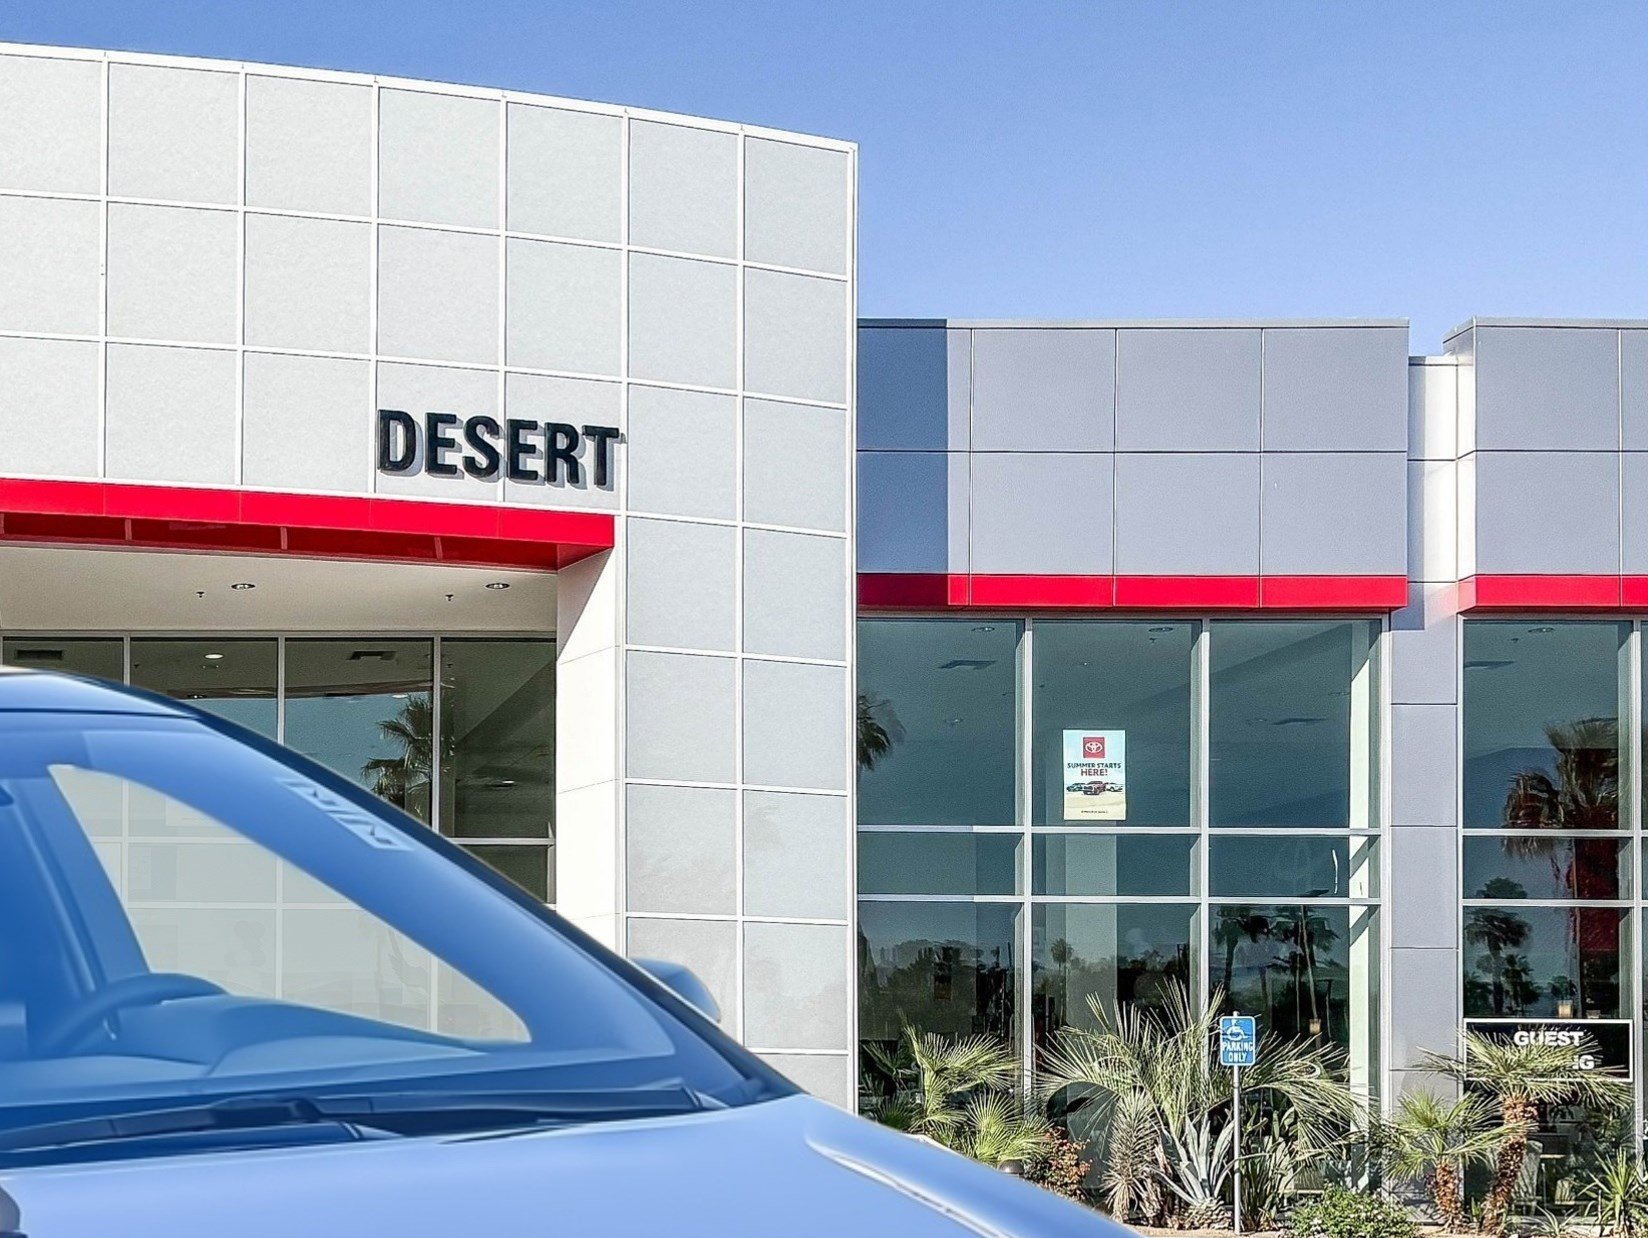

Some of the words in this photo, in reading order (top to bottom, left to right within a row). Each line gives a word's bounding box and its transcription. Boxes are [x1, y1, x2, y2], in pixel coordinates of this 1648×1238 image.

[377, 409, 619, 486] DESERT
[1080, 768, 1108, 776] HERE!
[1513, 1030, 1584, 1047] GUEST
[1222, 1041, 1254, 1052] PARKING
[1228, 1051, 1248, 1062] ONLY
